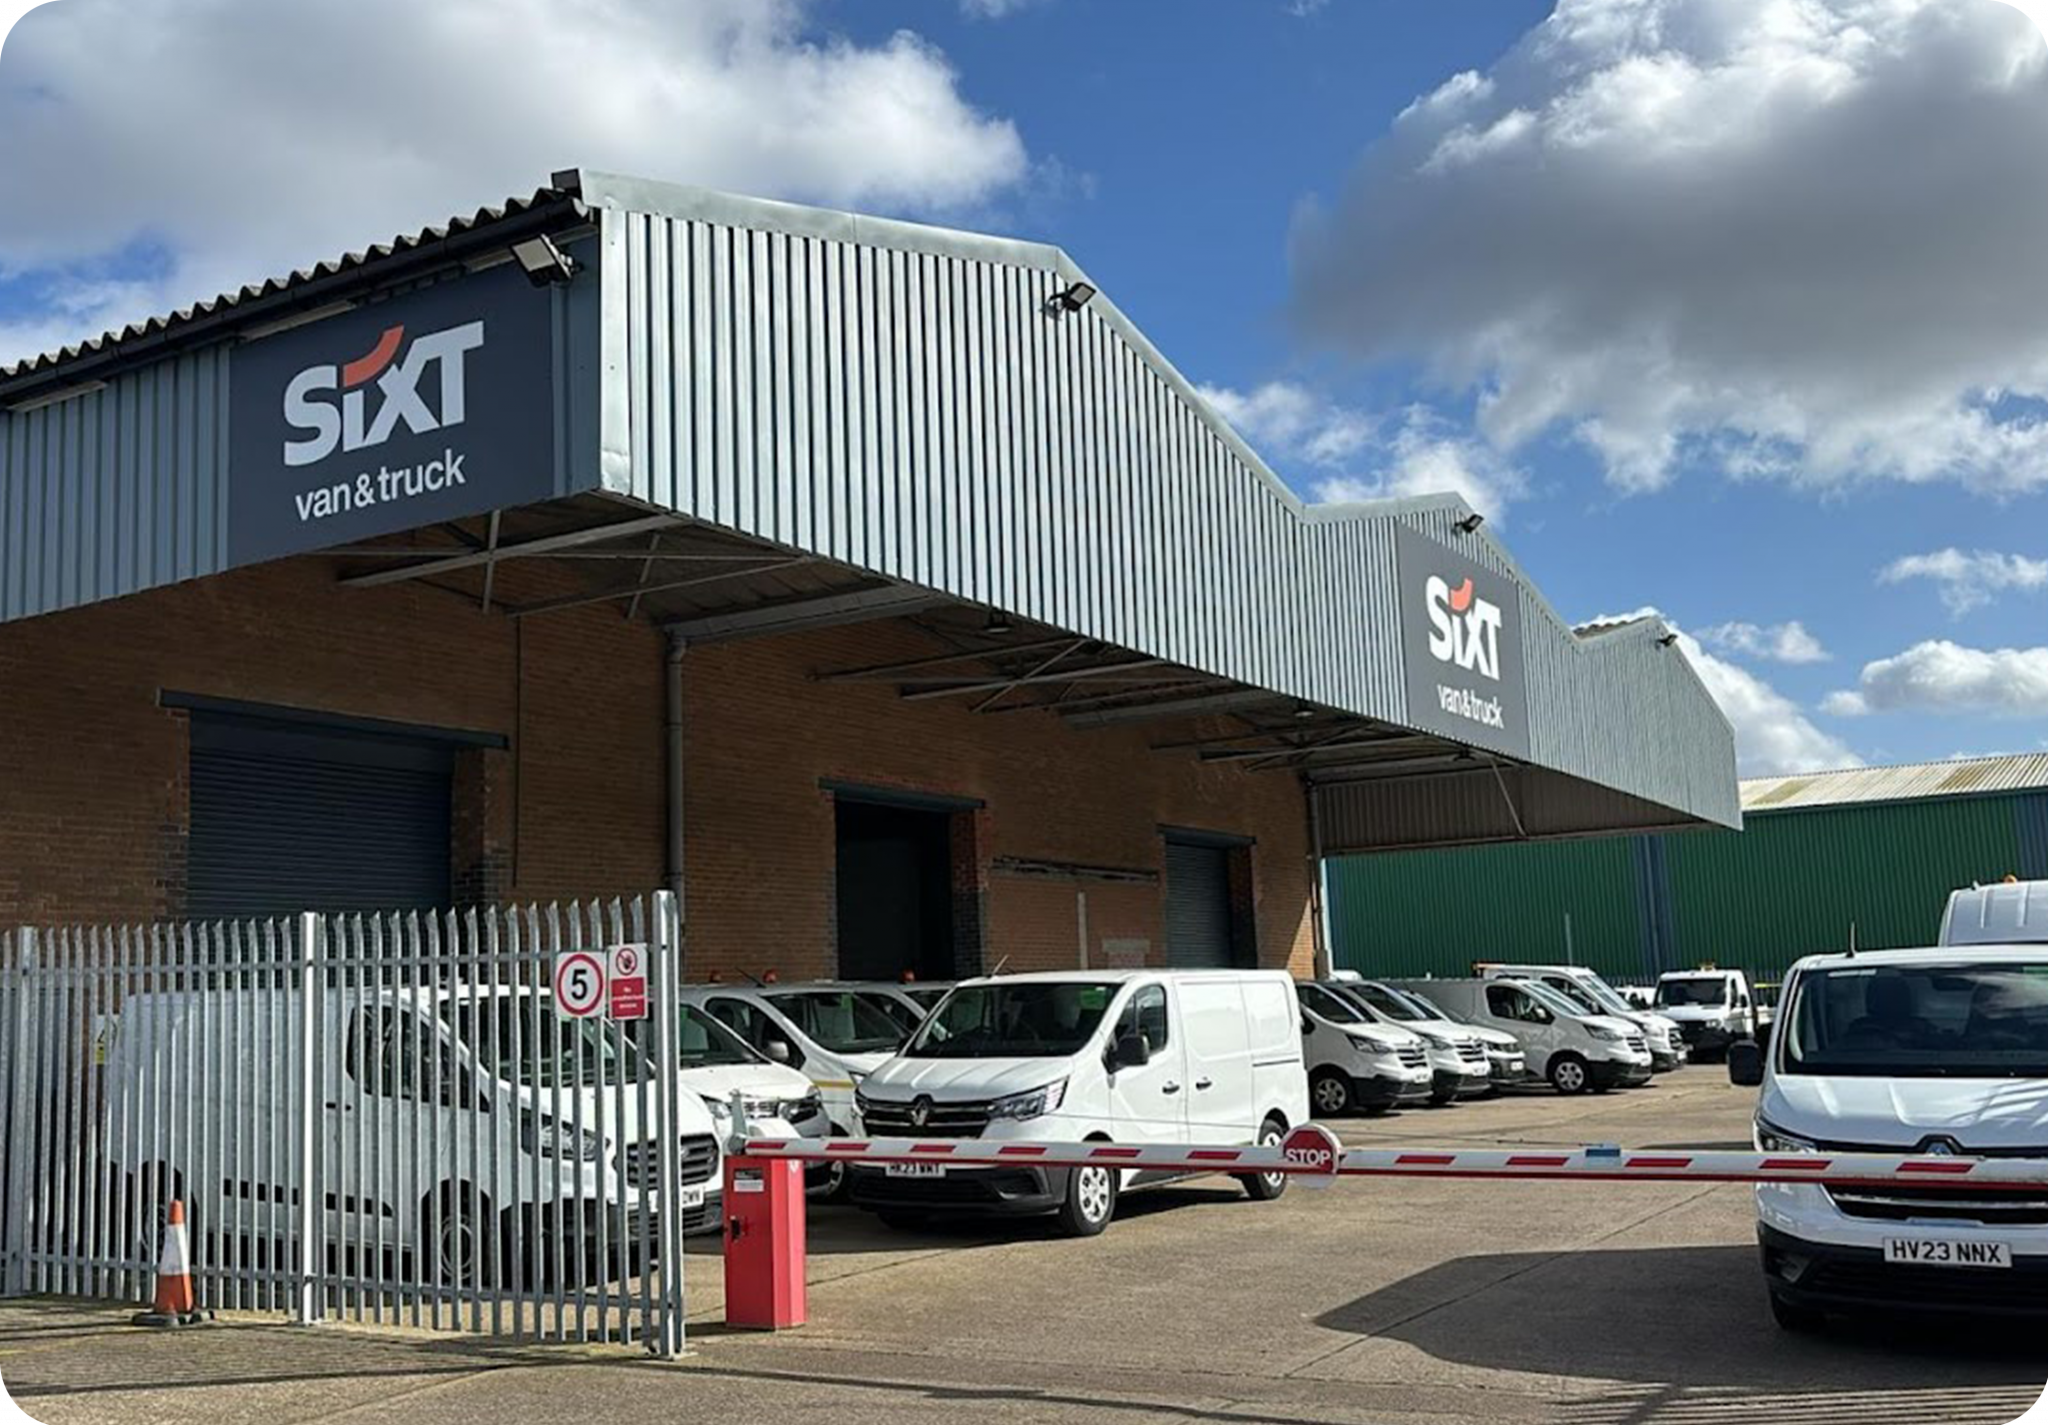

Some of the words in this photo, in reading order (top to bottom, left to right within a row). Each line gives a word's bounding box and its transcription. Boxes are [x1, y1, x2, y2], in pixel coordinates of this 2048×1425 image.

[571, 969, 588, 1000] 5
[1286, 1147, 1332, 1167] STOP
[1892, 1239, 1951, 1261] HV23
[1956, 1242, 2003, 1264] NNX
